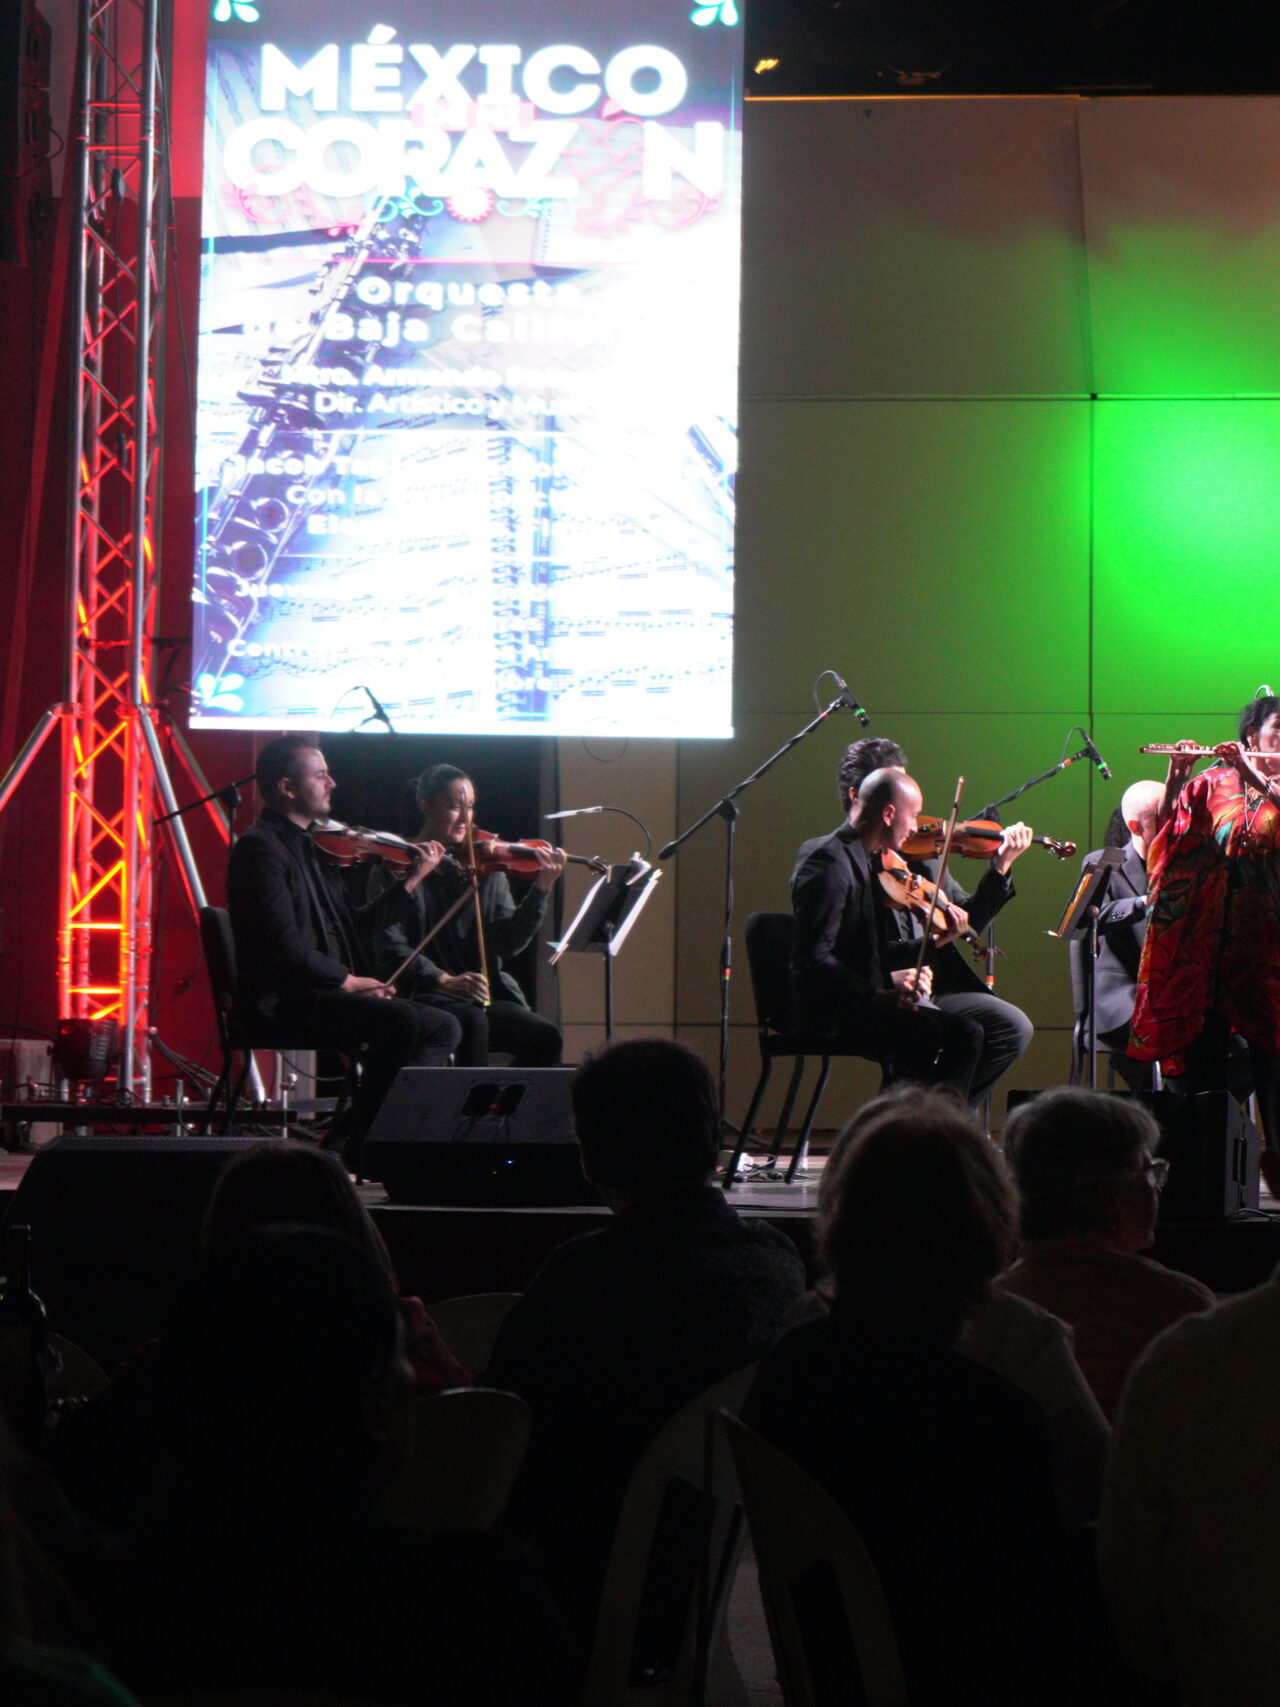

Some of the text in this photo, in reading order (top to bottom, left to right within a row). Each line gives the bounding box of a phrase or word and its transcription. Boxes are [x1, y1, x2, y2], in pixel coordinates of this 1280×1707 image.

[261, 24, 688, 116] MÉXICO
[324, 315, 429, 346] Baja
[316, 392, 363, 414] Dir.
[367, 393, 485, 415] Artístico
[287, 486, 346, 506] Con
